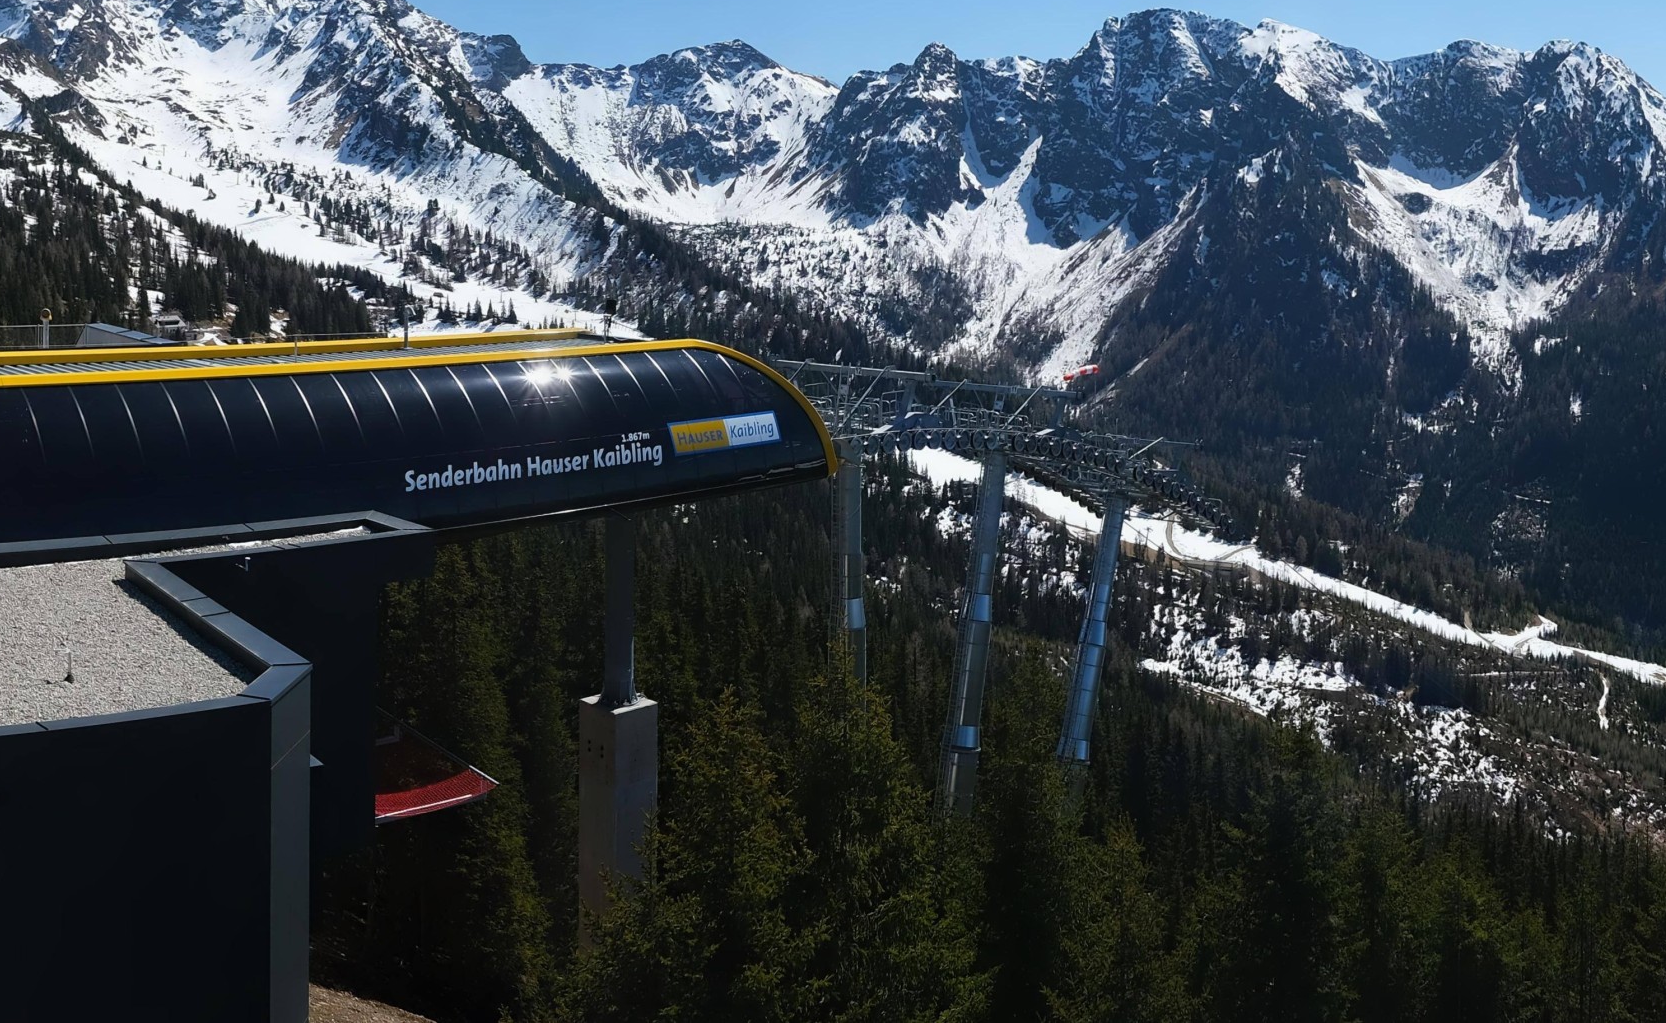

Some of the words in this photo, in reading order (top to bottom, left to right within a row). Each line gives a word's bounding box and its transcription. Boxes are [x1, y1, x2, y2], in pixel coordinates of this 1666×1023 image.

[621, 431, 650, 443] 1.867m
[730, 423, 774, 439] Kaibling
[405, 458, 522, 492] Senderbahn
[527, 454, 589, 477] Hauser
[593, 442, 663, 468] Kaibling
